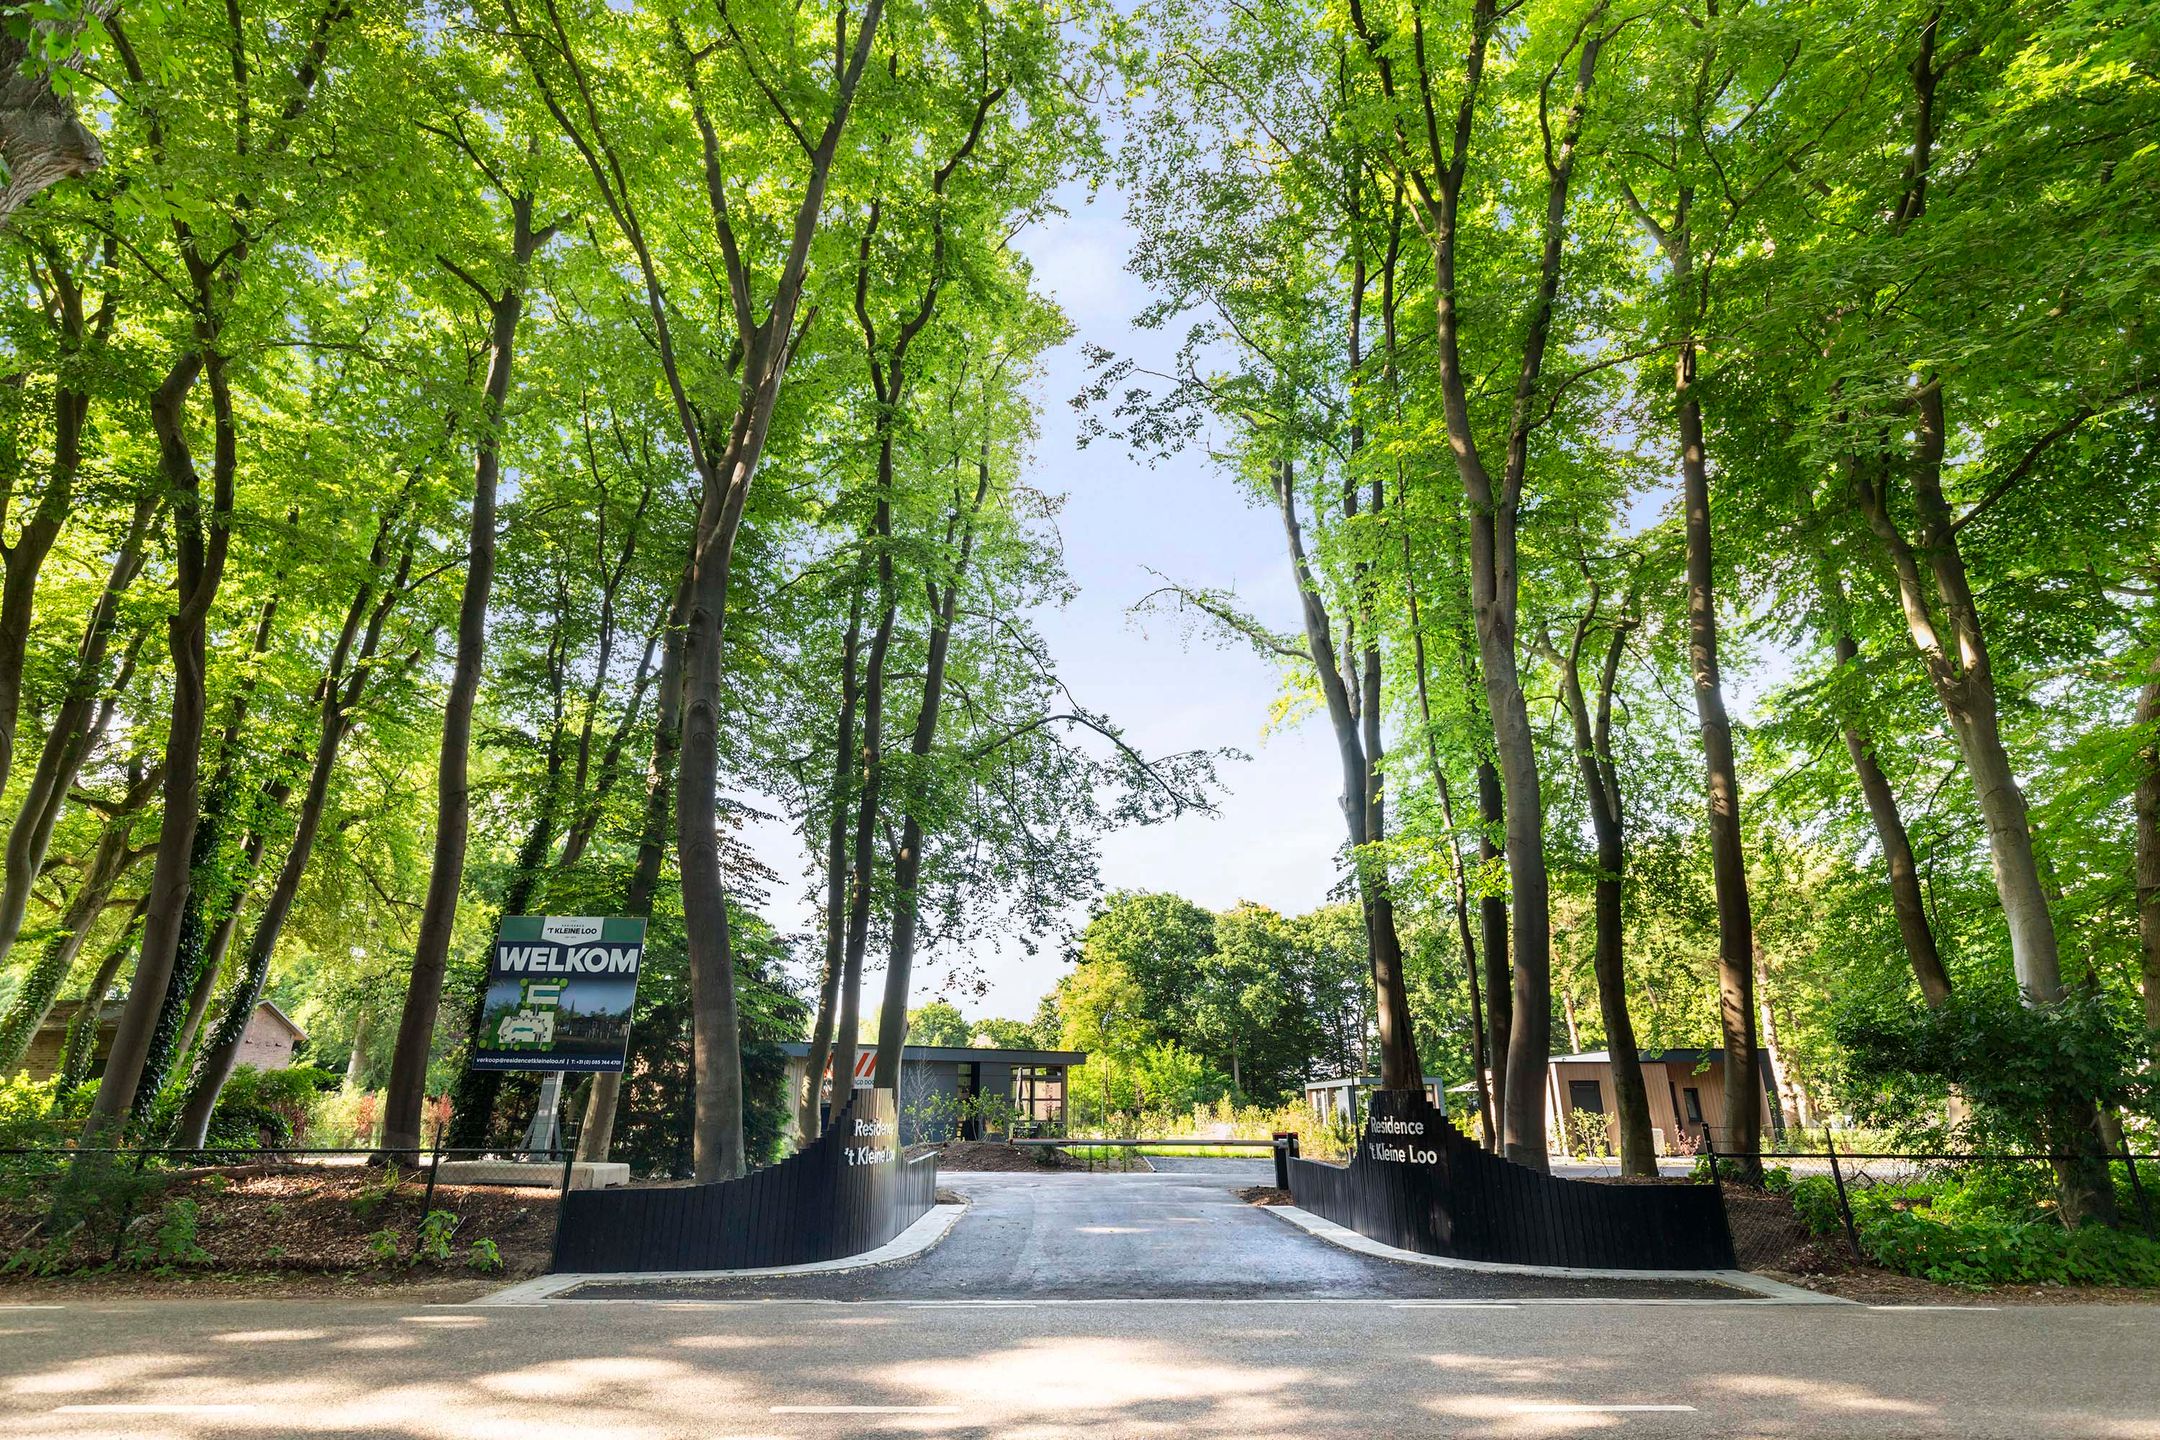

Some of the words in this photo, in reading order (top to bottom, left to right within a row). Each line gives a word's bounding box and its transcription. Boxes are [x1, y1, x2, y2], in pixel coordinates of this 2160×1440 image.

[499, 947, 639, 973] WELKOM
[1370, 1115, 1424, 1135] Residence
[844, 1147, 855, 1166] 't
[856, 1146, 885, 1165] Kleine
[1376, 1142, 1406, 1163] Kleine
[1408, 1144, 1438, 1165] Loo
